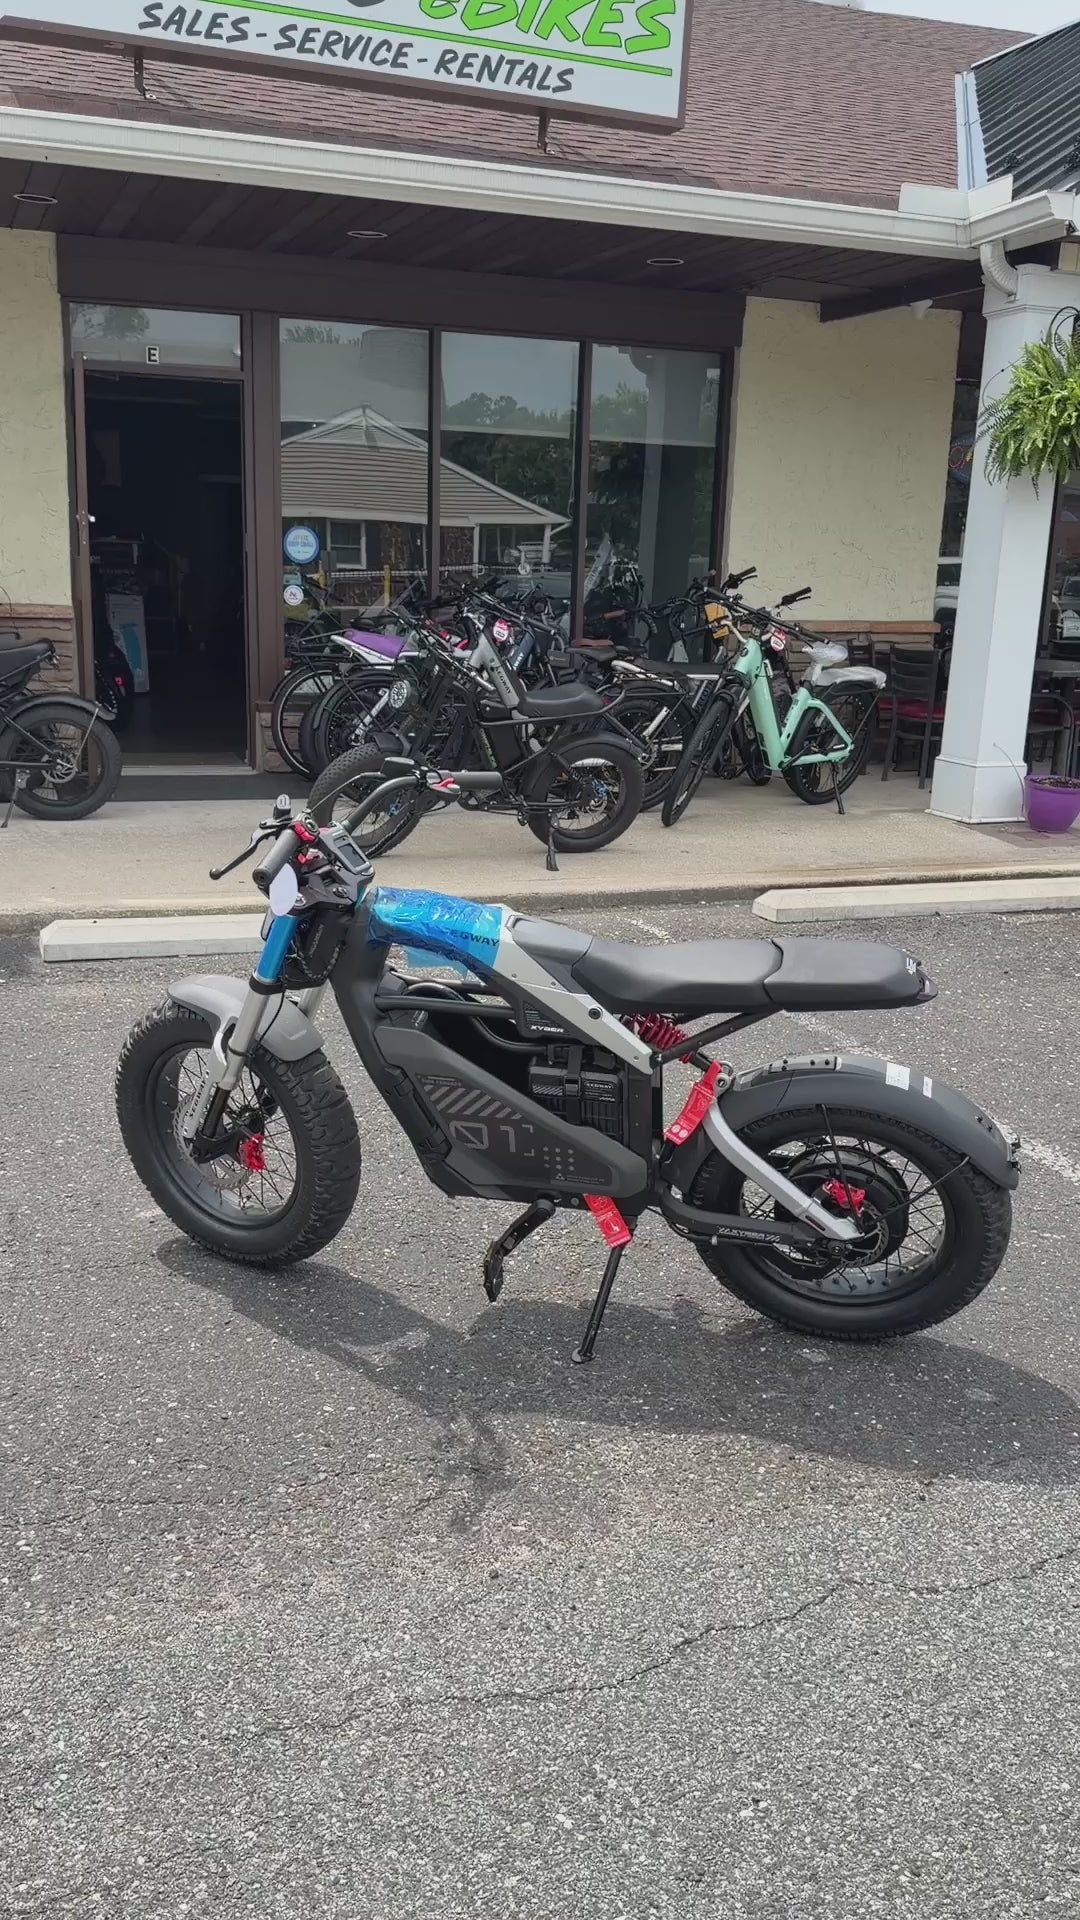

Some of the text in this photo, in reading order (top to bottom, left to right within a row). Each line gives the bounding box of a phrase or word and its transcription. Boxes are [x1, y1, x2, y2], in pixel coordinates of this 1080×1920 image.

[138, 2, 250, 43] SALES
[273, 24, 413, 69] SERVICE
[433, 48, 574, 93] RENTALS
[147, 347, 158, 363] E
[530, 1024, 564, 1033] XYBER
